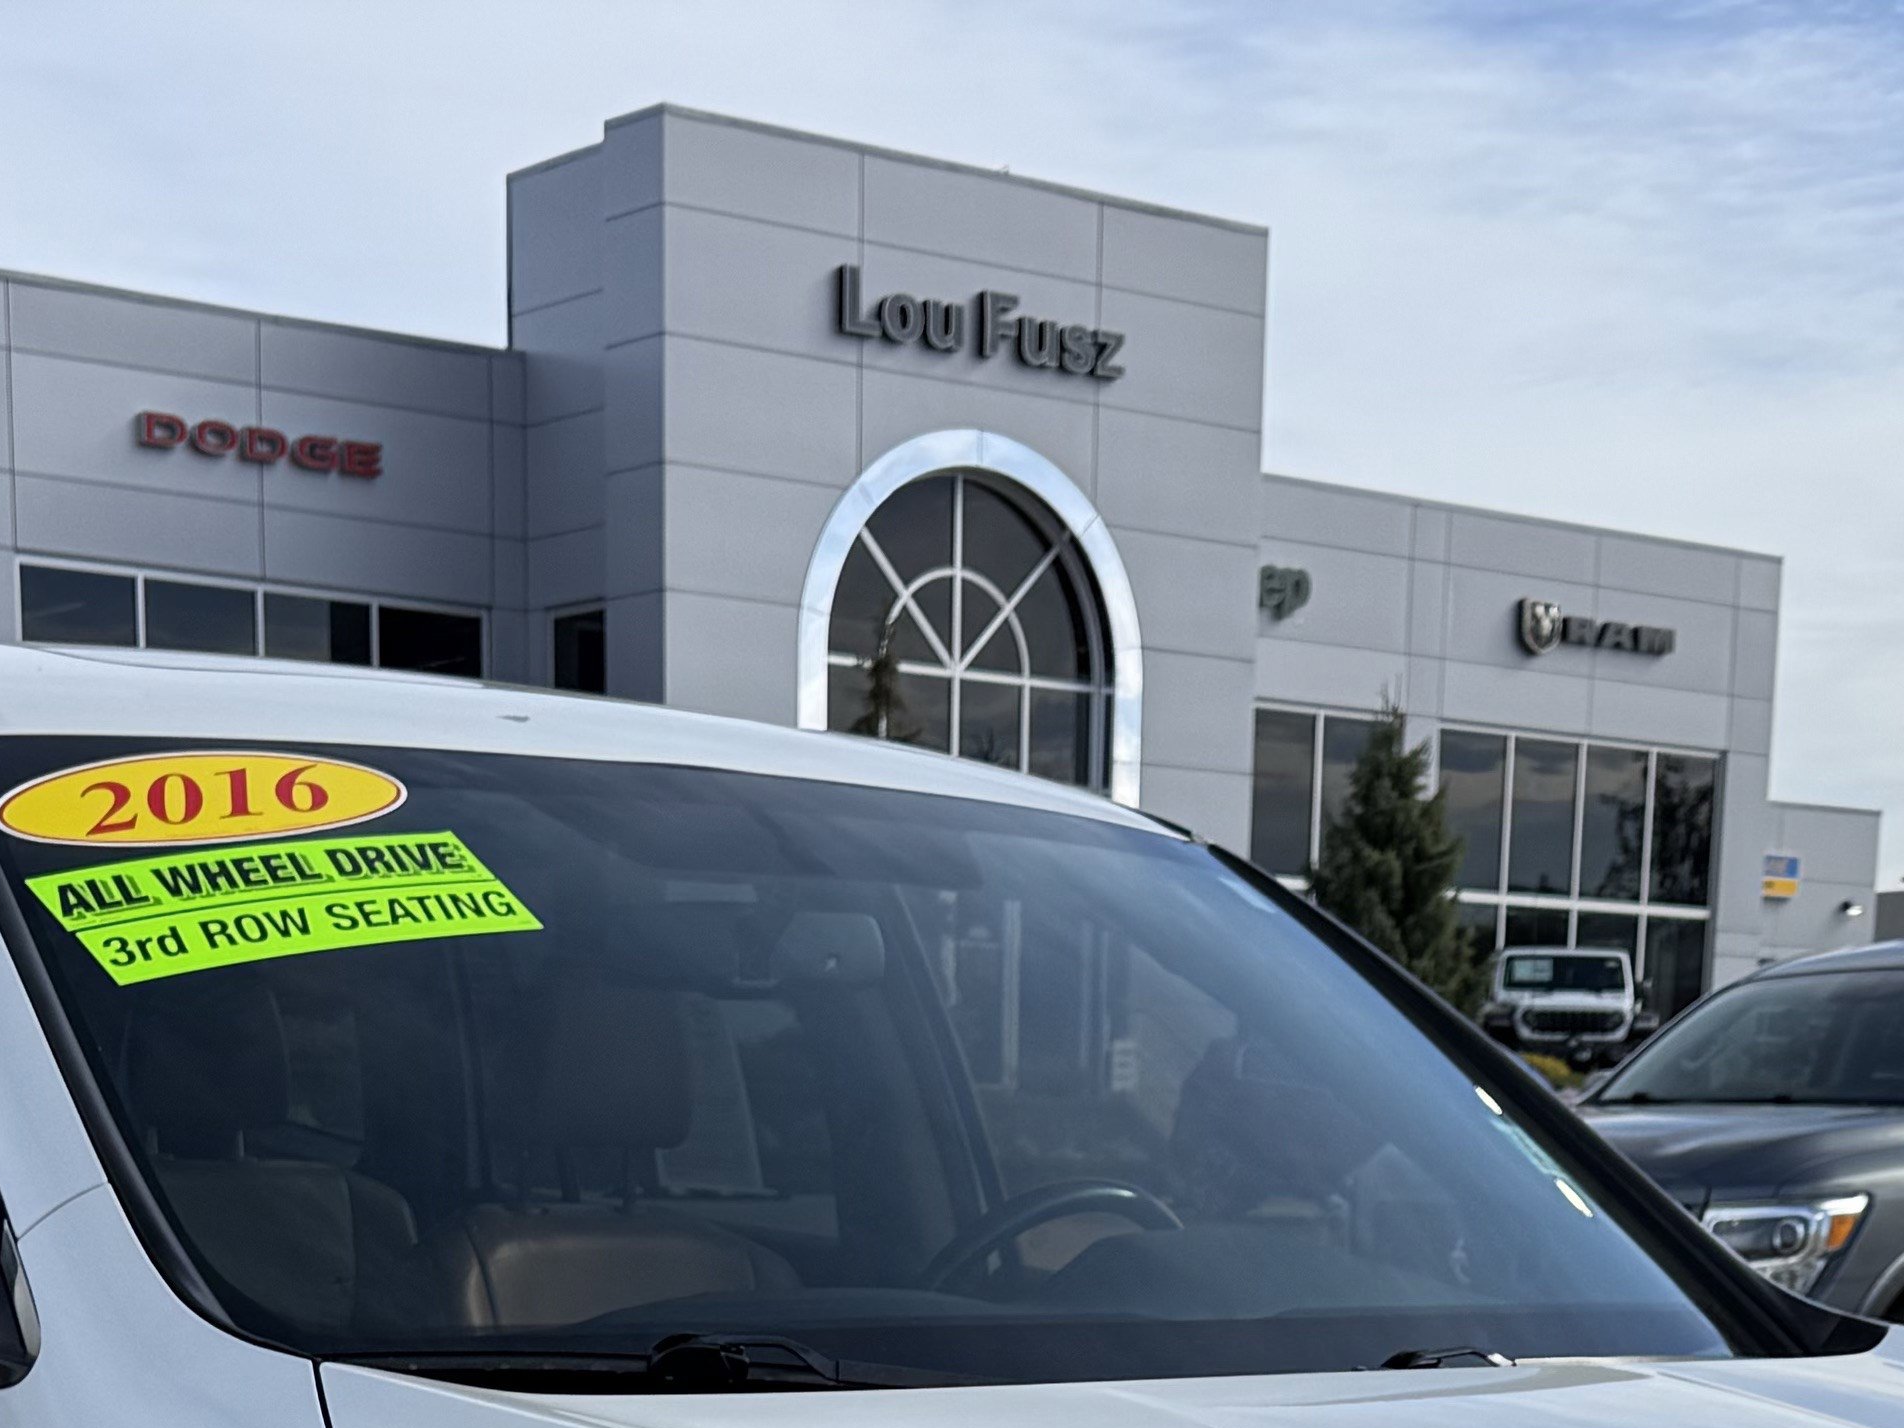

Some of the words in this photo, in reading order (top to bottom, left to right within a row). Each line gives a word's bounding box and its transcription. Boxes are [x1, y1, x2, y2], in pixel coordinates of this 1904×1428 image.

[834, 264, 964, 352] Lou
[978, 290, 1126, 378] Fusz
[136, 411, 383, 479] DODGE
[1562, 616, 1676, 656] RAM
[81, 765, 329, 835] 2016
[56, 877, 156, 918] ALL
[151, 852, 326, 900] WHEEL
[324, 840, 470, 880] DRIVE
[102, 925, 188, 968] 3rd
[199, 906, 312, 950] ROW
[325, 890, 518, 932] SEATING
